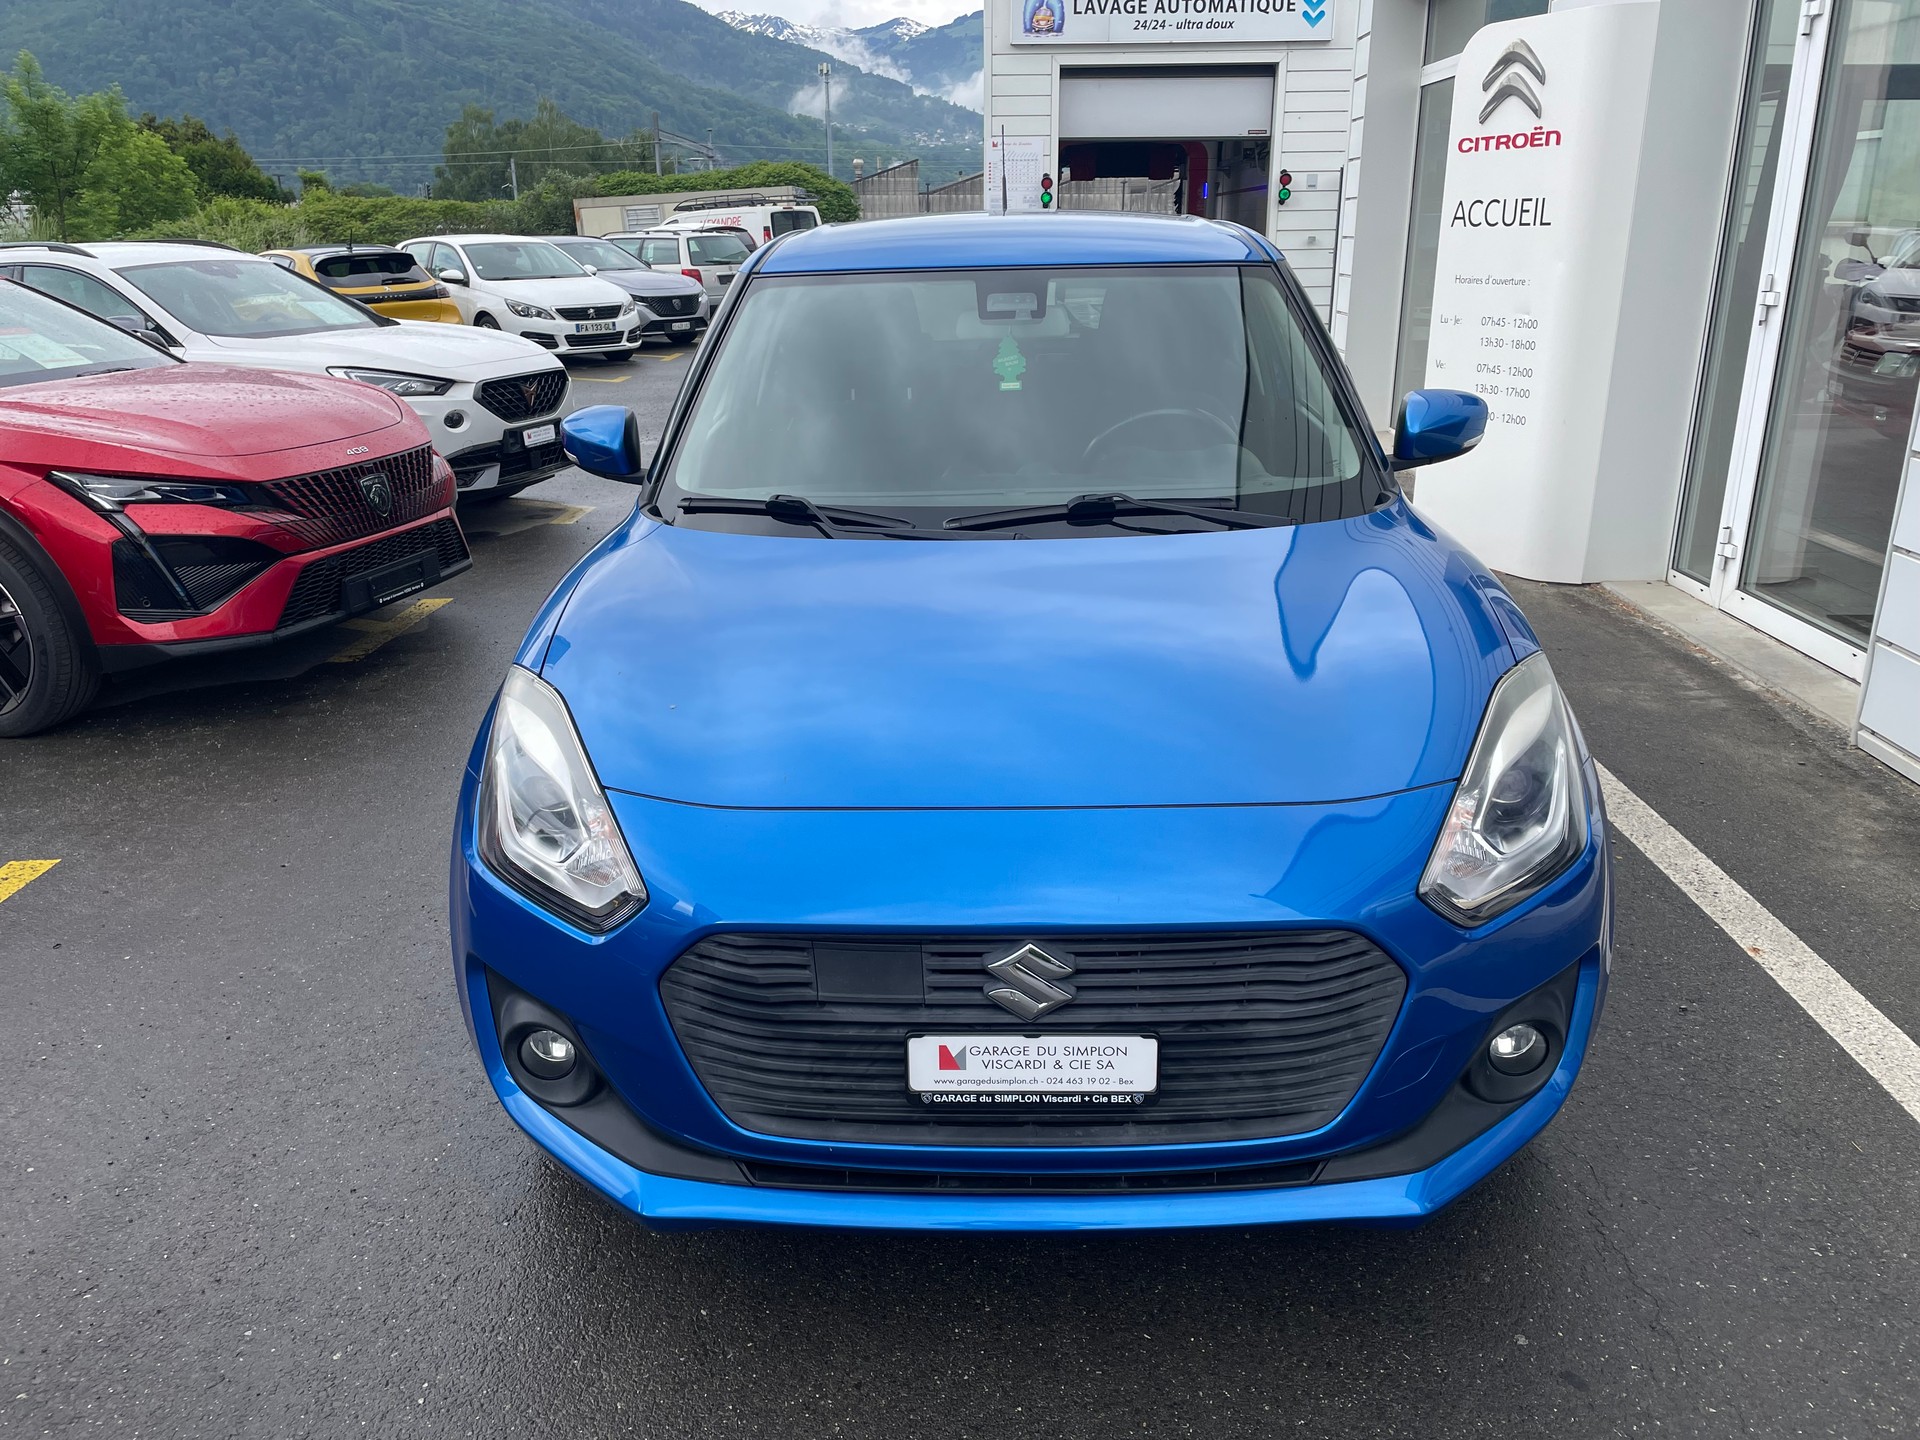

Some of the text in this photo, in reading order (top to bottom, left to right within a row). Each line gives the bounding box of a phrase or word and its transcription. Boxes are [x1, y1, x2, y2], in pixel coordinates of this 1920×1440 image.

[1073, 0, 1297, 14] LAVAGE AUTOMATIQUE
[1133, 19, 1166, 31] 24/24
[1176, 19, 1203, 30] ultra
[1206, 18, 1235, 30] doux
[1451, 198, 1551, 227] ACCUEIL
[1455, 275, 1483, 285] Horaires
[1481, 316, 1506, 327] 07h45
[1513, 318, 1539, 330] 12h00
[1480, 337, 1504, 348] 13h30
[1511, 339, 1536, 351] 18h00
[1476, 363, 1501, 375] 07h45
[1508, 366, 1533, 378] 12h00
[1475, 384, 1499, 395] 13h30
[1505, 386, 1531, 399] 17h00
[1501, 413, 1527, 426] 12h00
[346, 445, 369, 456] 408
[969, 1046, 1128, 1056] GARAGE DU SIMPLON
[981, 1060, 1115, 1069] VISCARDI & CIE SA
[934, 1077, 1039, 1086] www.garagedusimplon.ch
[1119, 1077, 1134, 1085] Bex
[933, 1094, 977, 1103] GARAGE
[980, 1094, 992, 1103] du
[994, 1094, 1040, 1103] SIMPLON
[1042, 1094, 1082, 1103] Viscardi
[1092, 1094, 1108, 1103] Cie
[1110, 1095, 1132, 1103] BEX
